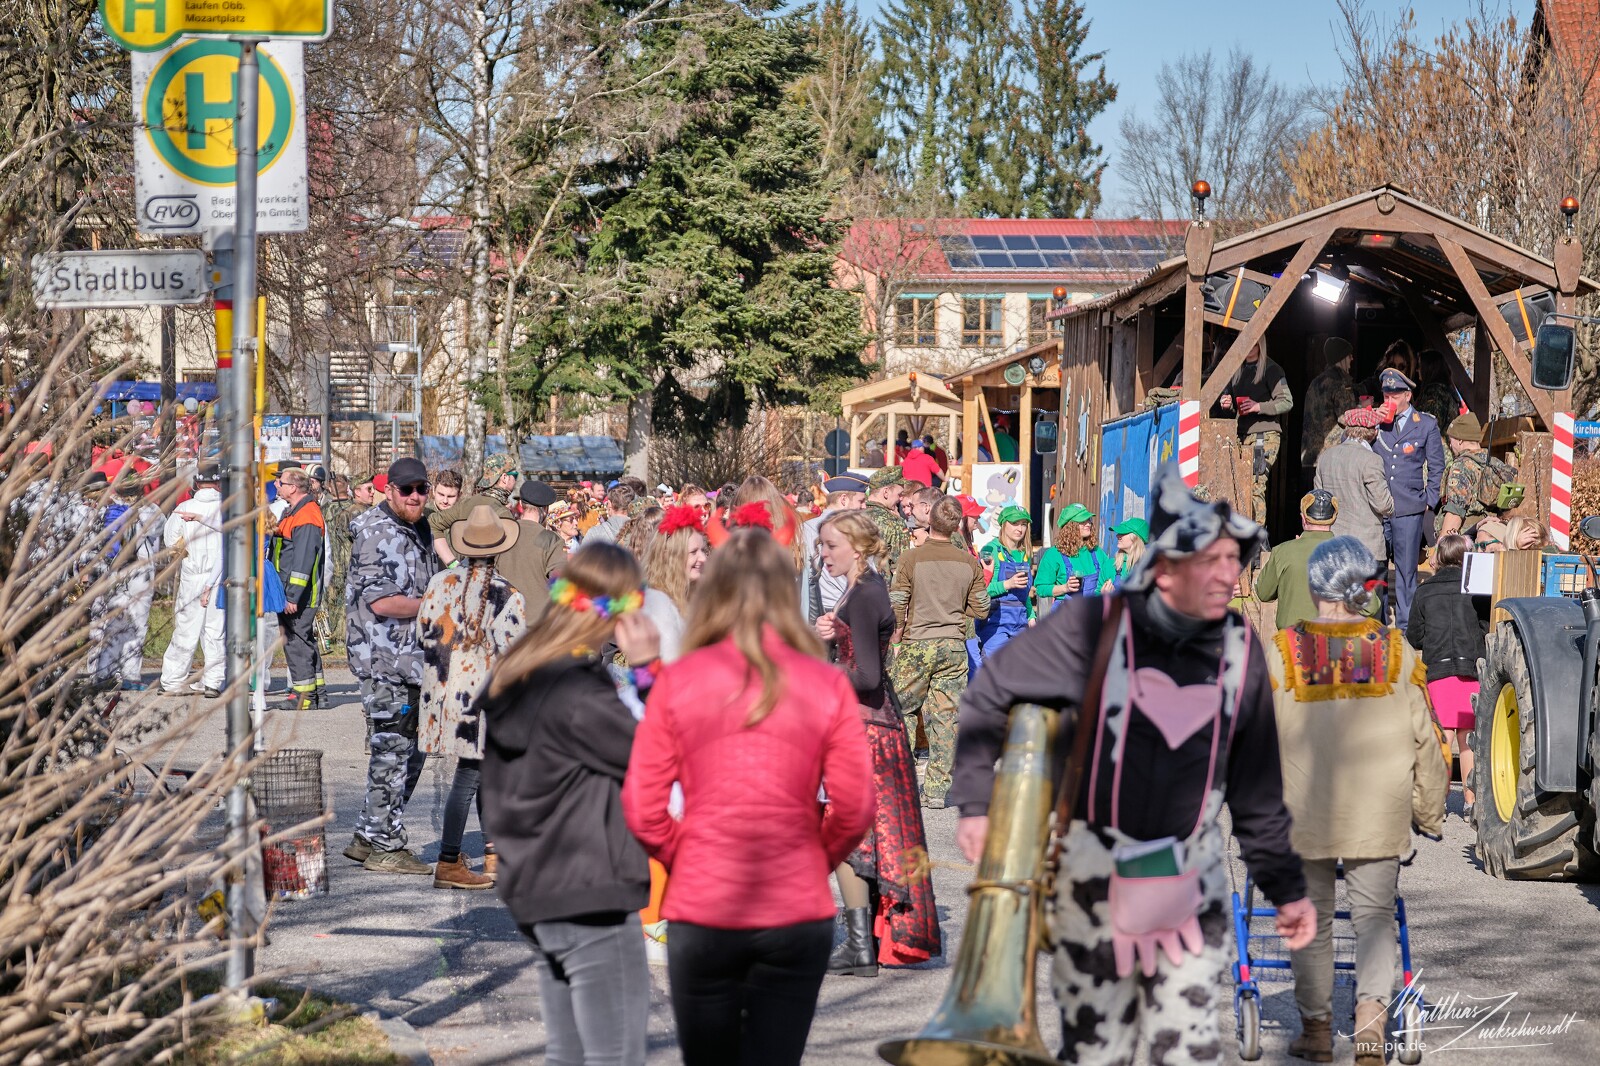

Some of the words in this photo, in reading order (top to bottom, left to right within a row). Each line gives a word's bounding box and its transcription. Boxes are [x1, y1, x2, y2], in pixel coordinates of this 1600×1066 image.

[184, 1, 219, 10] Laufen
[222, 1, 245, 10] Obb.
[124, 0, 165, 32] H
[184, 13, 245, 24] Mozartplatz
[185, 72, 239, 149] H
[211, 194, 299, 206] Regiverkehr
[154, 204, 193, 218] RVO
[269, 208, 299, 217] GmbH
[55, 265, 184, 291] Stadtbus
